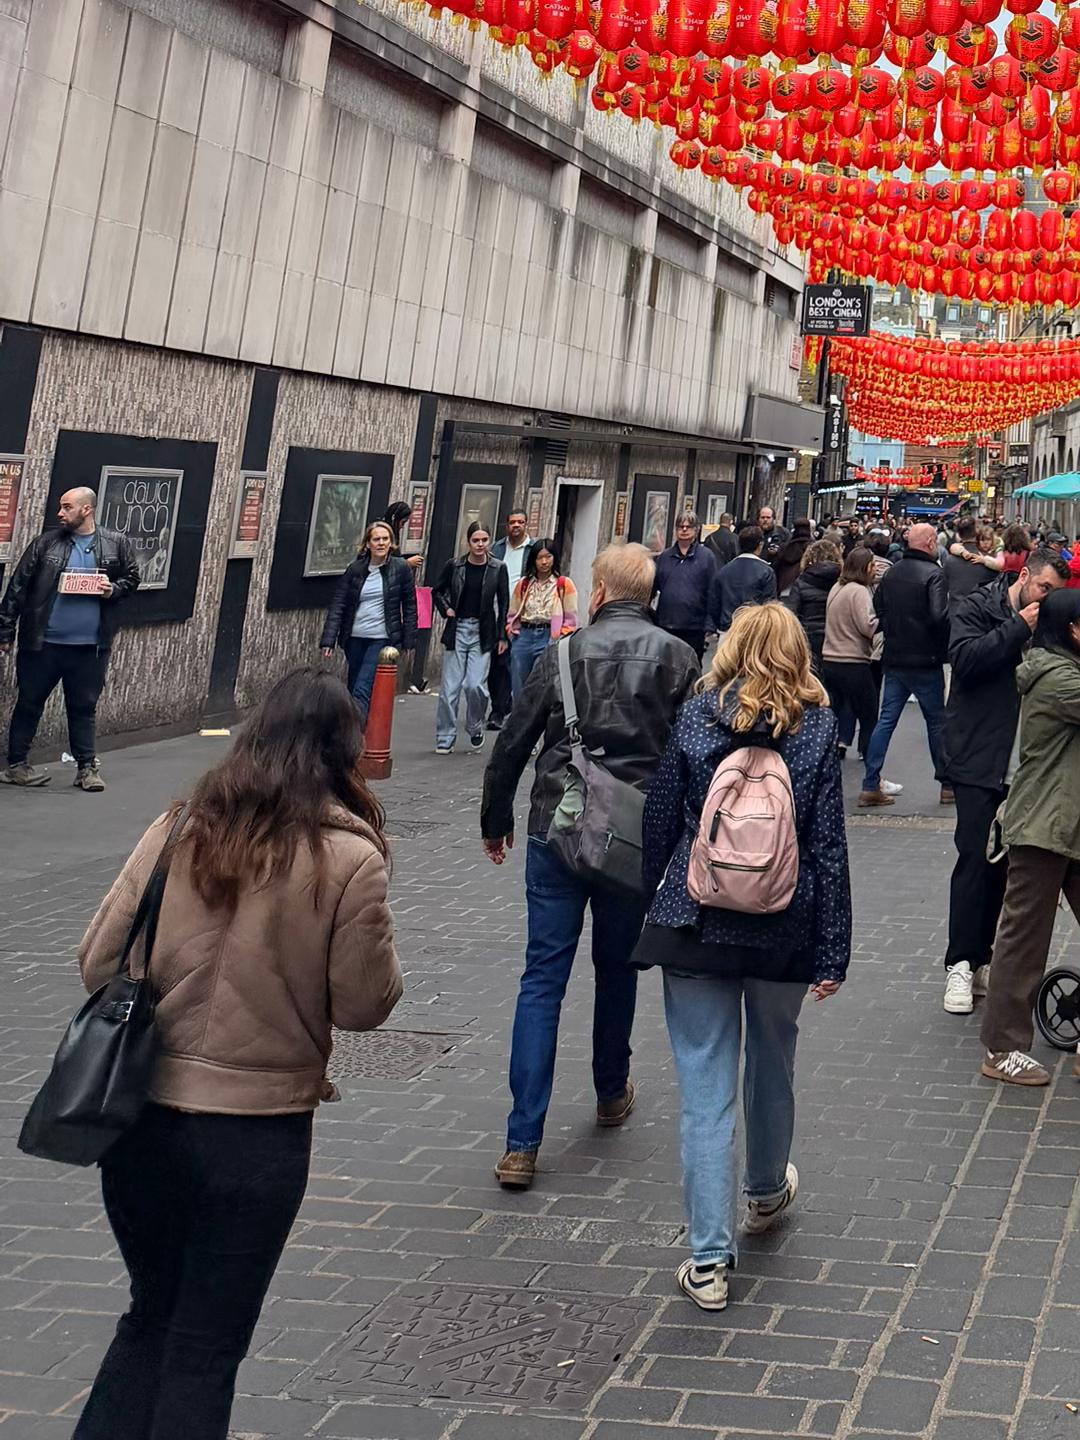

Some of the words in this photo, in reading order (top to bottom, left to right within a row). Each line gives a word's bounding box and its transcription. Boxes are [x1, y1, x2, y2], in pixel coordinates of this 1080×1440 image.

[809, 296, 862, 309] LONDON'S
[808, 307, 830, 317] BEST
[832, 308, 862, 318] CINEMA
[124, 480, 171, 505] david
[105, 502, 169, 536] lynch
